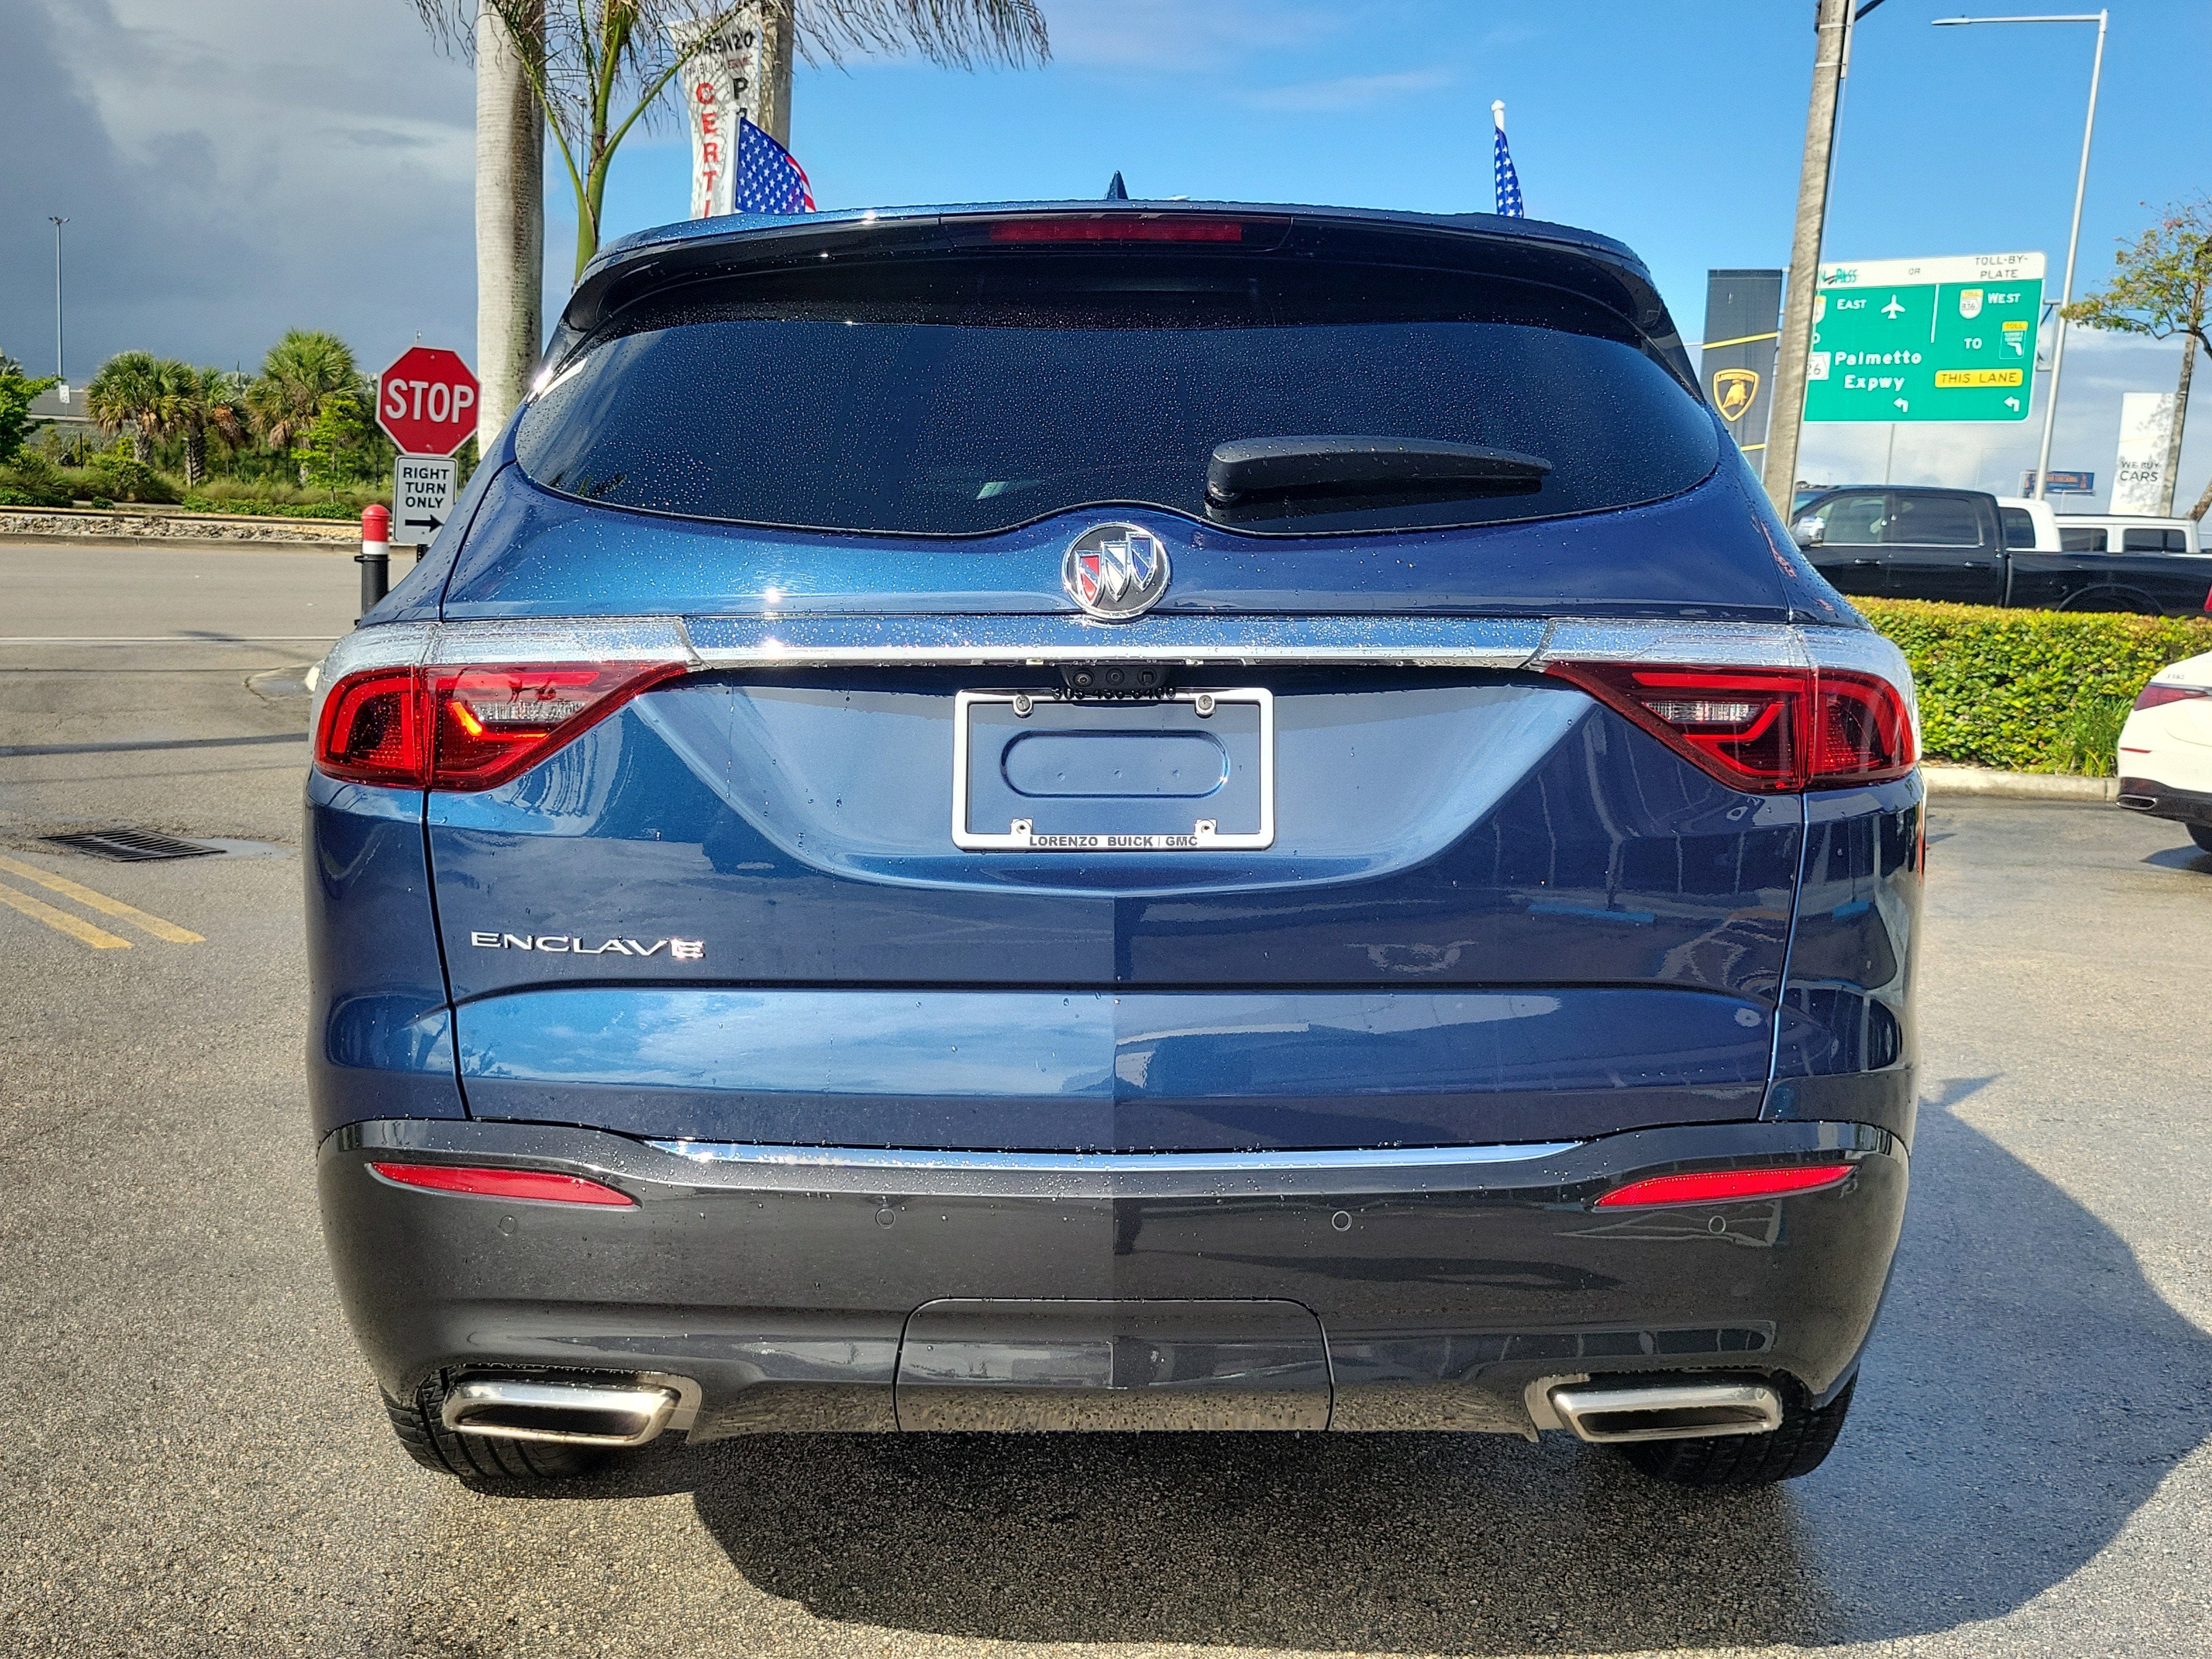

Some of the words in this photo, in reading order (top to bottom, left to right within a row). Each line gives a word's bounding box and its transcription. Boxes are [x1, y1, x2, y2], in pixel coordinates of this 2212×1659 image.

[1980, 269, 2018, 279] PLATE
[1837, 298, 1867, 310] EAST
[1988, 292, 2021, 304] WEST
[1963, 337, 1983, 349] TO
[1835, 349, 1922, 366] Palmetto
[1844, 374, 1905, 391] Expwy
[1940, 374, 1971, 383] THIS
[1979, 373, 2017, 383] LANE
[385, 378, 475, 424] STOP
[403, 467, 450, 480] RIGHT
[2120, 470, 2159, 482] CARS
[405, 482, 446, 494] TURN
[405, 496, 444, 509] ONLY
[1029, 836, 1098, 847] LORENZO
[1107, 836, 1153, 847] BUICK
[1165, 836, 1198, 847] GMC
[471, 930, 706, 958] ENCLAVE
